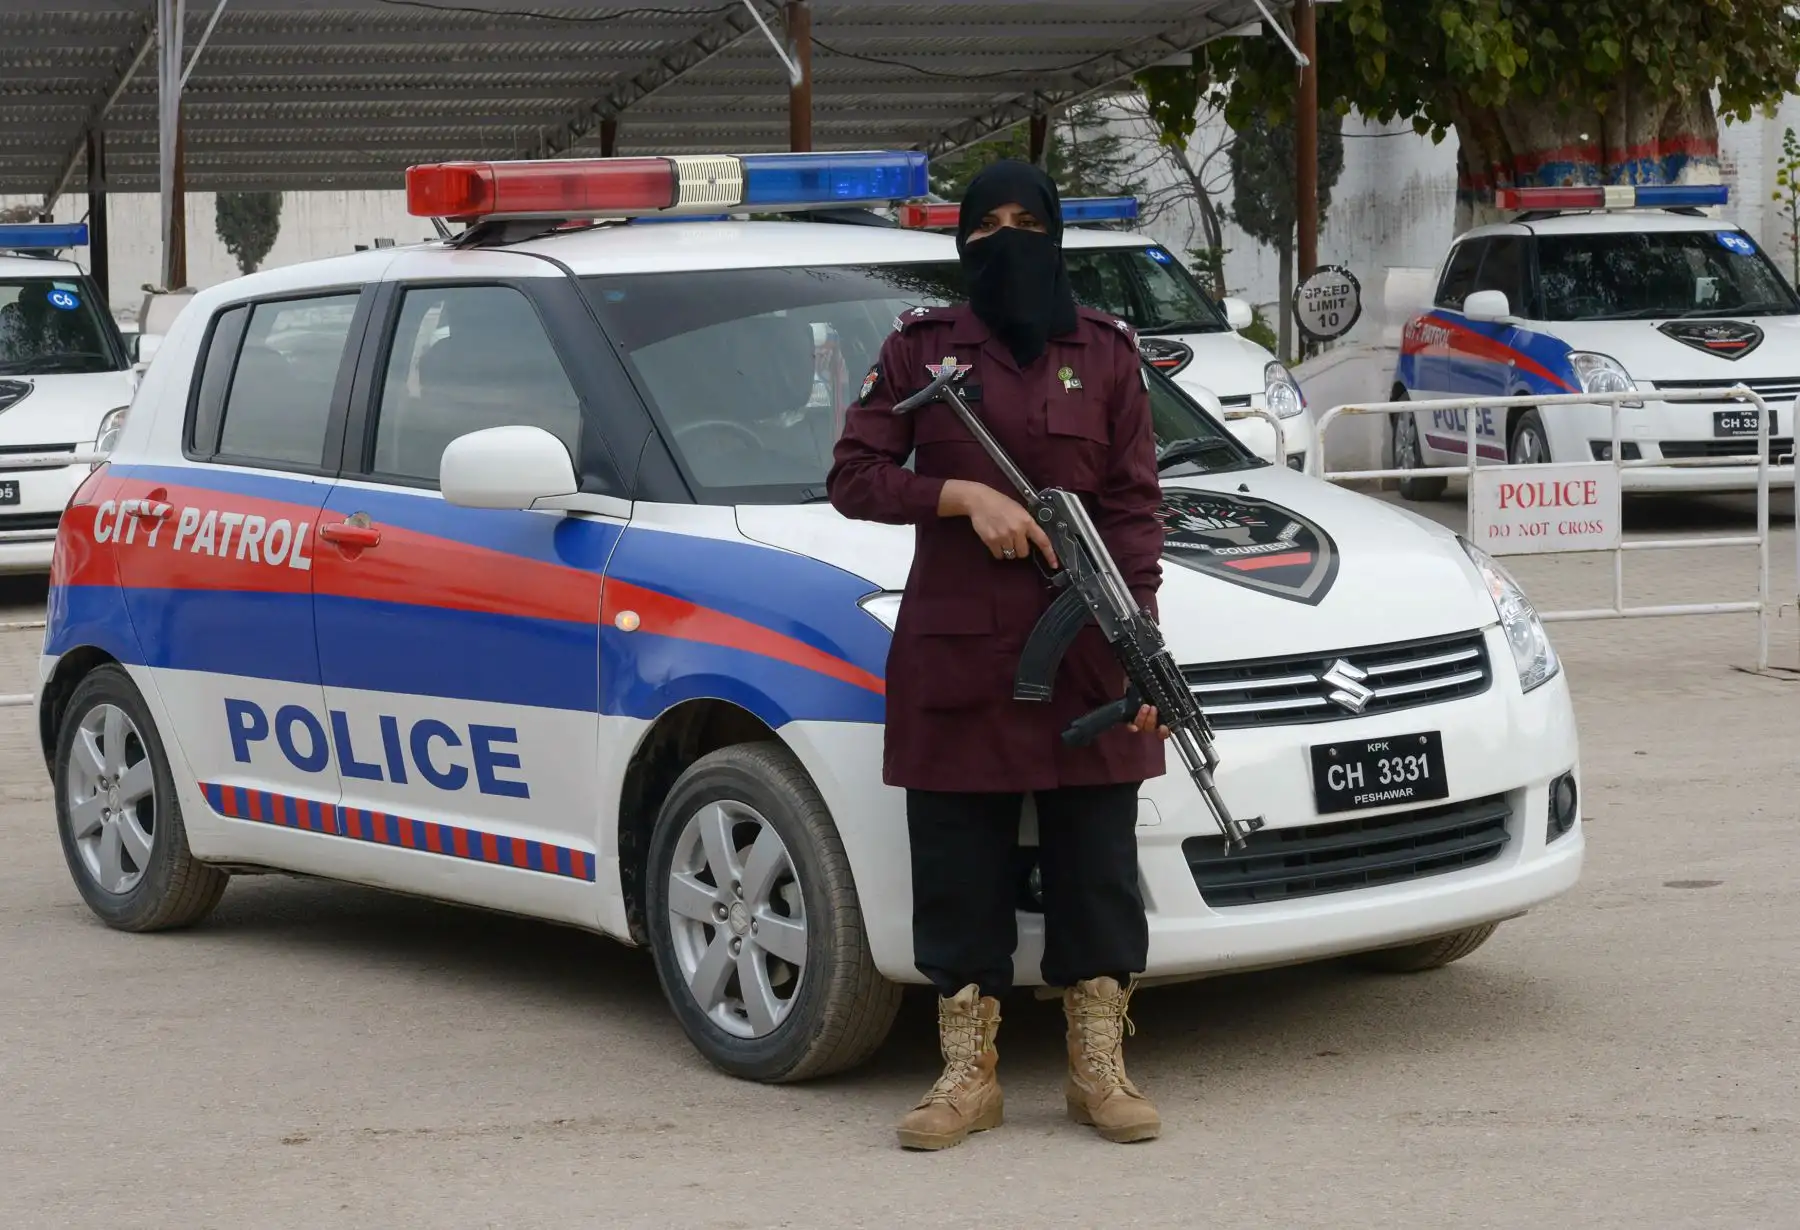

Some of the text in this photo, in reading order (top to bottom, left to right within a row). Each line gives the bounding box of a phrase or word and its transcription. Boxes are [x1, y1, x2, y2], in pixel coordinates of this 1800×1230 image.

[1305, 284, 1350, 300] SPEED
[1309, 298, 1347, 312] LIMIT
[1318, 312, 1340, 328] 10
[1433, 408, 1495, 436] POLCE
[1721, 418, 1758, 428] CH 33
[1498, 480, 1598, 510] POLICE
[93, 500, 312, 571] CITY PATROL
[1489, 519, 1604, 538] DO NOT CROSS
[1163, 540, 1210, 551] URAGE
[1215, 541, 1291, 556] COURTESY
[224, 698, 531, 799] POLICE
[1366, 742, 1390, 753] KPK
[1327, 753, 1430, 791] CH 3331
[1354, 787, 1414, 804] PESHAWAR
